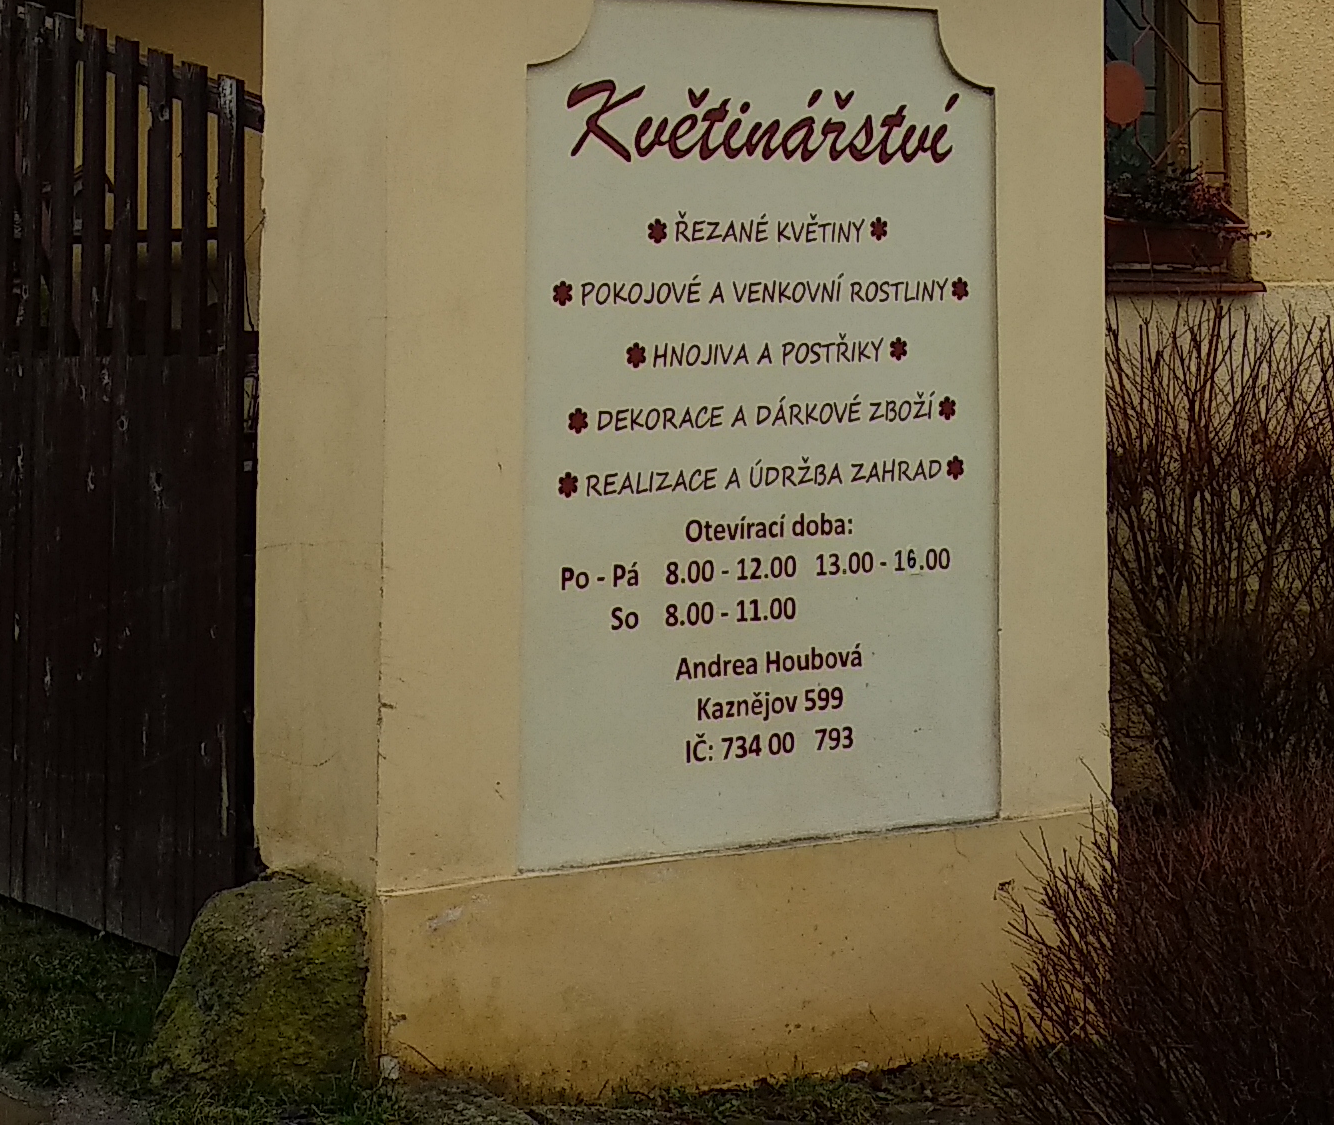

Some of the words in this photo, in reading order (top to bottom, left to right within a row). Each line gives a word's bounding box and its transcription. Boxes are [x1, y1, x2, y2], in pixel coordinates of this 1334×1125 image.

[568, 79, 959, 165] Květinářství
[675, 210, 768, 243] ŘEZANÉ
[778, 213, 865, 243] KVĚTINY
[581, 275, 701, 306] POKOJOVÉ
[708, 282, 724, 304] A
[733, 273, 844, 303] VENKOVNÍ
[850, 278, 948, 302] ROSTLINY
[653, 343, 749, 368] HNOJIVA
[757, 342, 772, 365] A
[782, 333, 884, 366] POSTŘIKY
[597, 406, 724, 431] DEKORACE
[731, 405, 747, 427] A
[756, 394, 861, 426] DÁRKOVÉ
[869, 391, 935, 422] ZBOŽÍ
[586, 468, 717, 497] REALIZACE
[725, 468, 740, 490] A
[750, 456, 843, 488] ÚDRŽBA
[851, 459, 942, 483] ZAHRAD
[686, 514, 785, 542] Otevírací
[792, 513, 852, 536] doba:
[562, 567, 589, 590] Po
[613, 562, 638, 587] Pá
[666, 560, 714, 585] 8.00
[737, 555, 796, 580] 12.00
[816, 551, 873, 576] 13.00
[895, 548, 950, 572] 16.00
[611, 607, 639, 630] So
[665, 602, 714, 627] 8.00
[737, 597, 796, 622] 11.00
[676, 654, 757, 680] Andrea
[766, 643, 862, 673] Houbová
[698, 692, 798, 721] Kaznějov
[805, 687, 843, 711] 599
[686, 733, 713, 763] IČ:
[721, 734, 762, 760] 734
[768, 732, 794, 755] 00
[815, 726, 853, 750] 793
